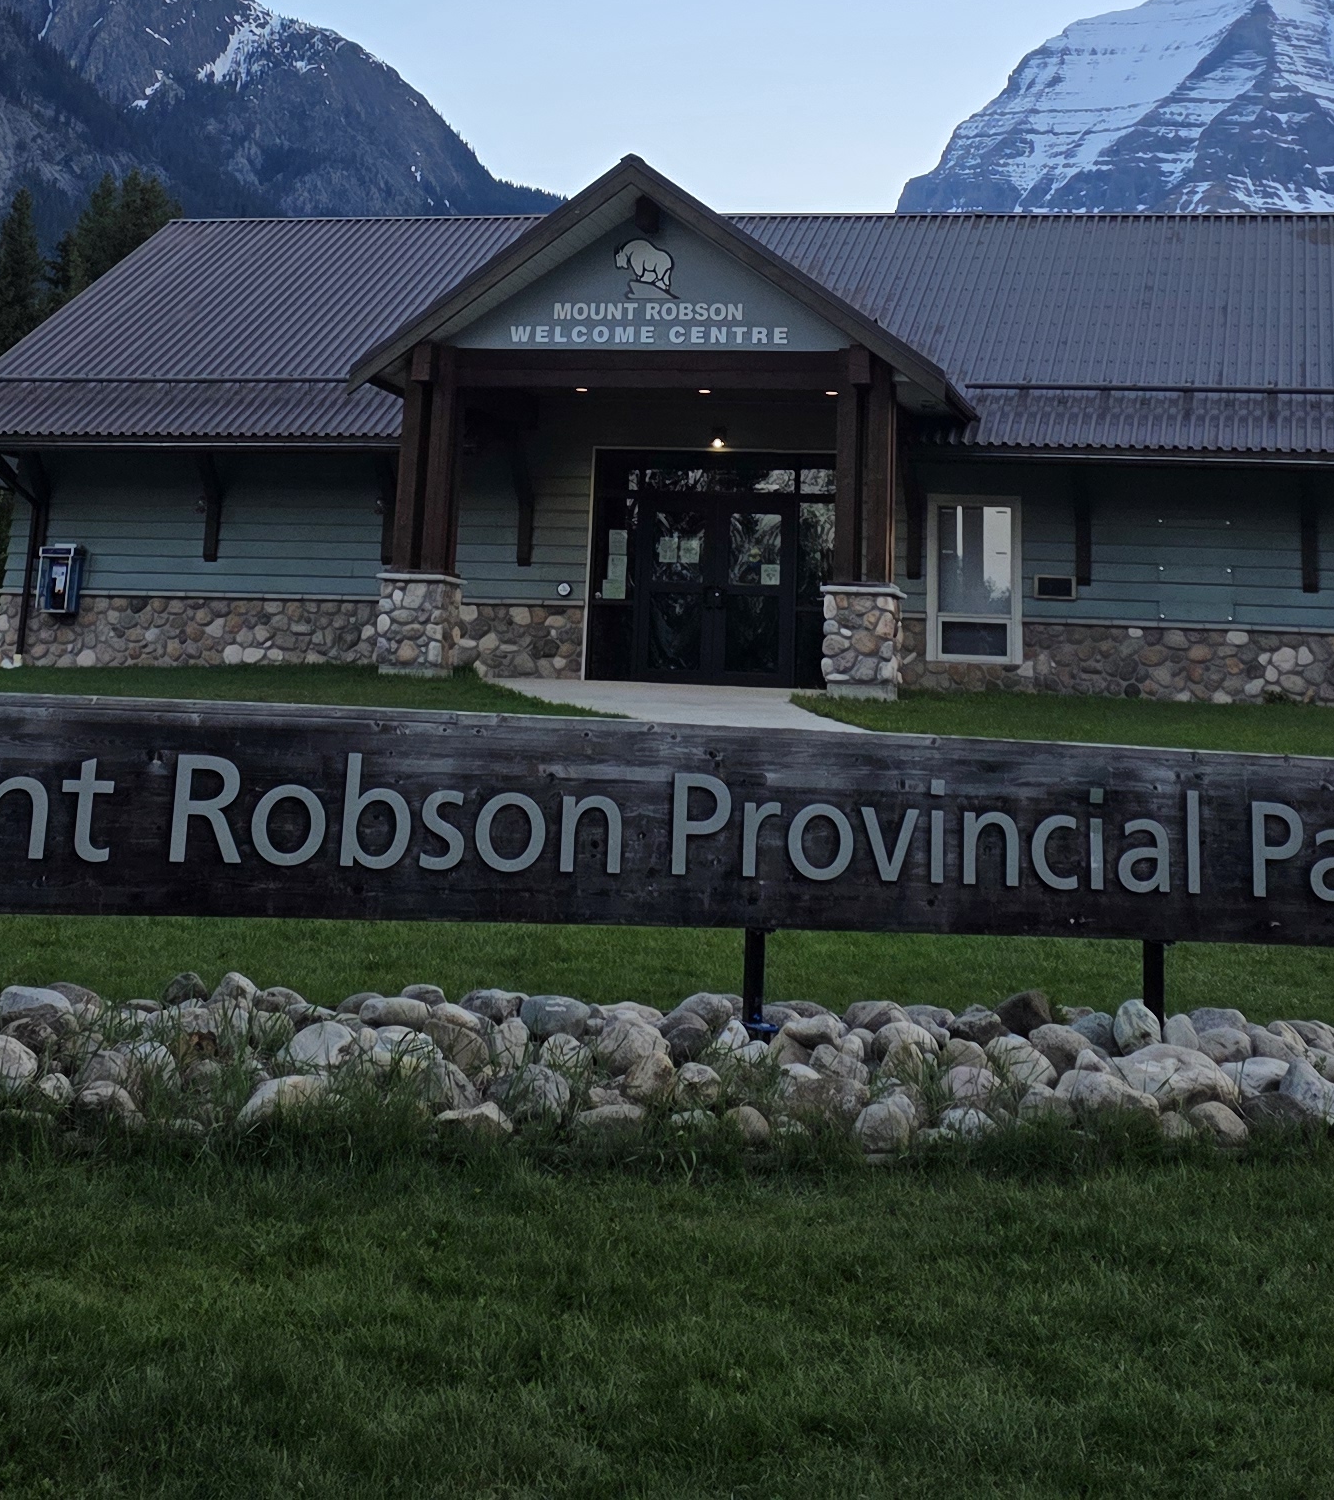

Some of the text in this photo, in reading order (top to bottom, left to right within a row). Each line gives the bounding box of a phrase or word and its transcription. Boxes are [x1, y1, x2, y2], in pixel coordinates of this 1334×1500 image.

[553, 302, 743, 320] MOUNT ROBSON
[510, 326, 788, 344] WELCOME CENTRE
[168, 752, 623, 875] Robson
[670, 772, 1202, 895] Provincial
